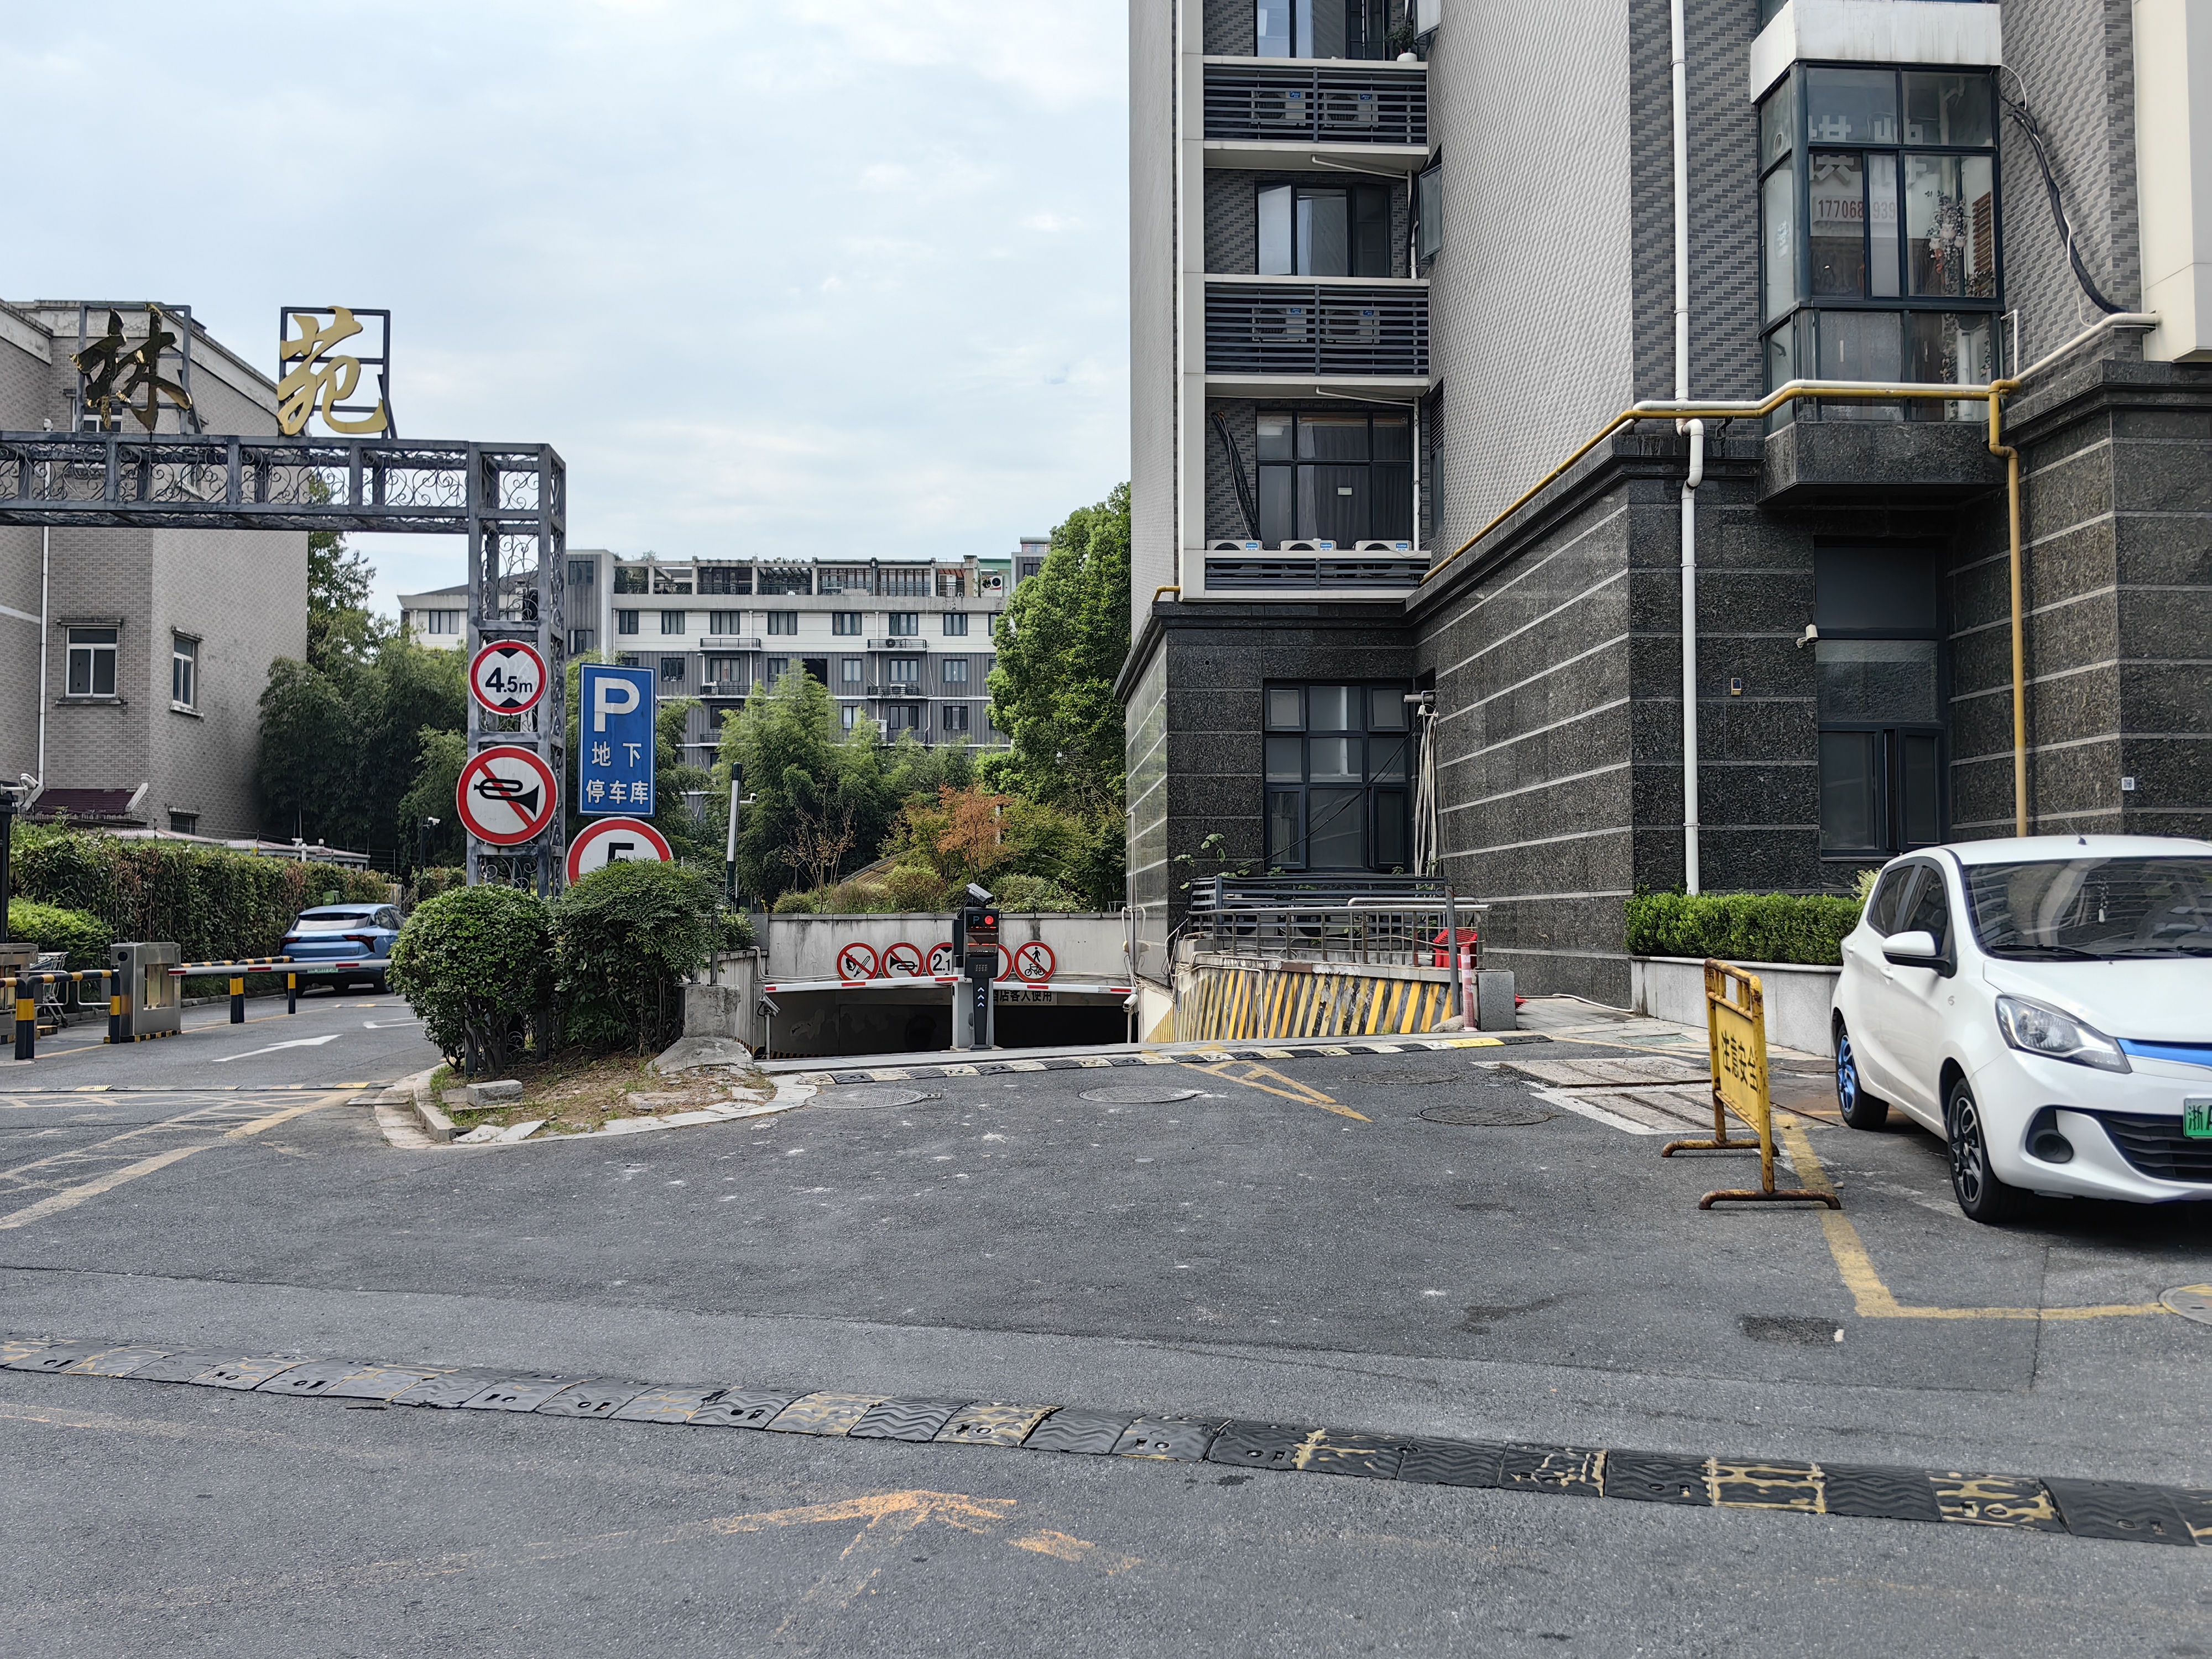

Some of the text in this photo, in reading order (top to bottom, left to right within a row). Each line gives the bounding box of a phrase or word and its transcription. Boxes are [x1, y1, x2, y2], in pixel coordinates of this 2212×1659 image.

[485, 667, 533, 693] 4.5m
[594, 677, 640, 732] P
[591, 741, 642, 768] 地下
[586, 779, 649, 804] 停车库
[1721, 1030, 1758, 1092] 注意安全
